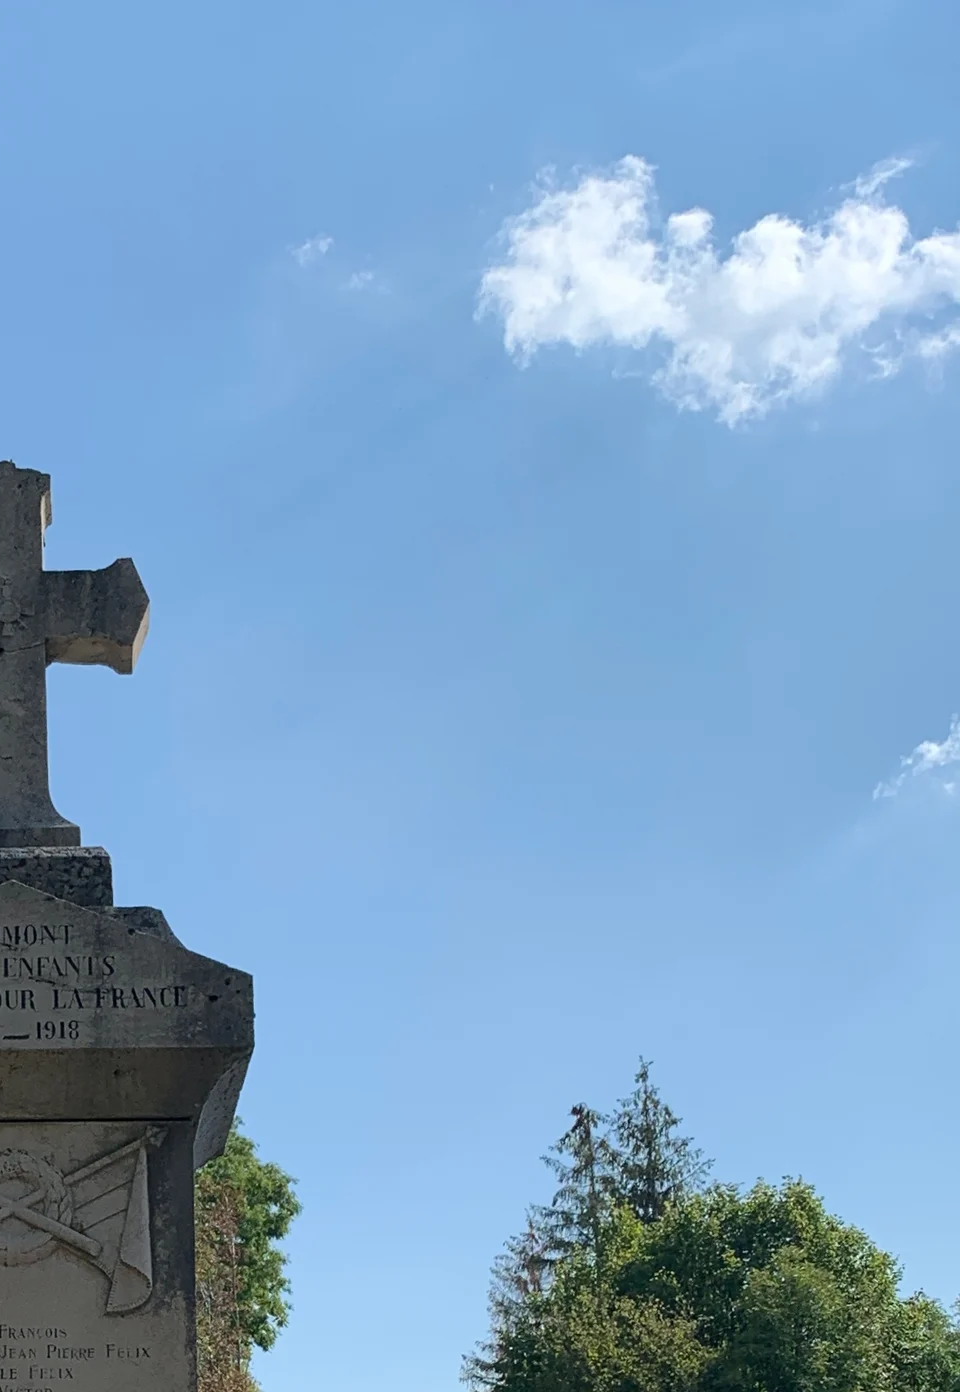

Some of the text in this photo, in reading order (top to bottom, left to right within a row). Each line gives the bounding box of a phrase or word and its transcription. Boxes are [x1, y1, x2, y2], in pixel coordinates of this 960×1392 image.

[3, 956, 116, 978] ENFANTS
[52, 990, 83, 1010] LA
[94, 985, 187, 1010] FRANCE
[36, 1020, 80, 1041] 1918
